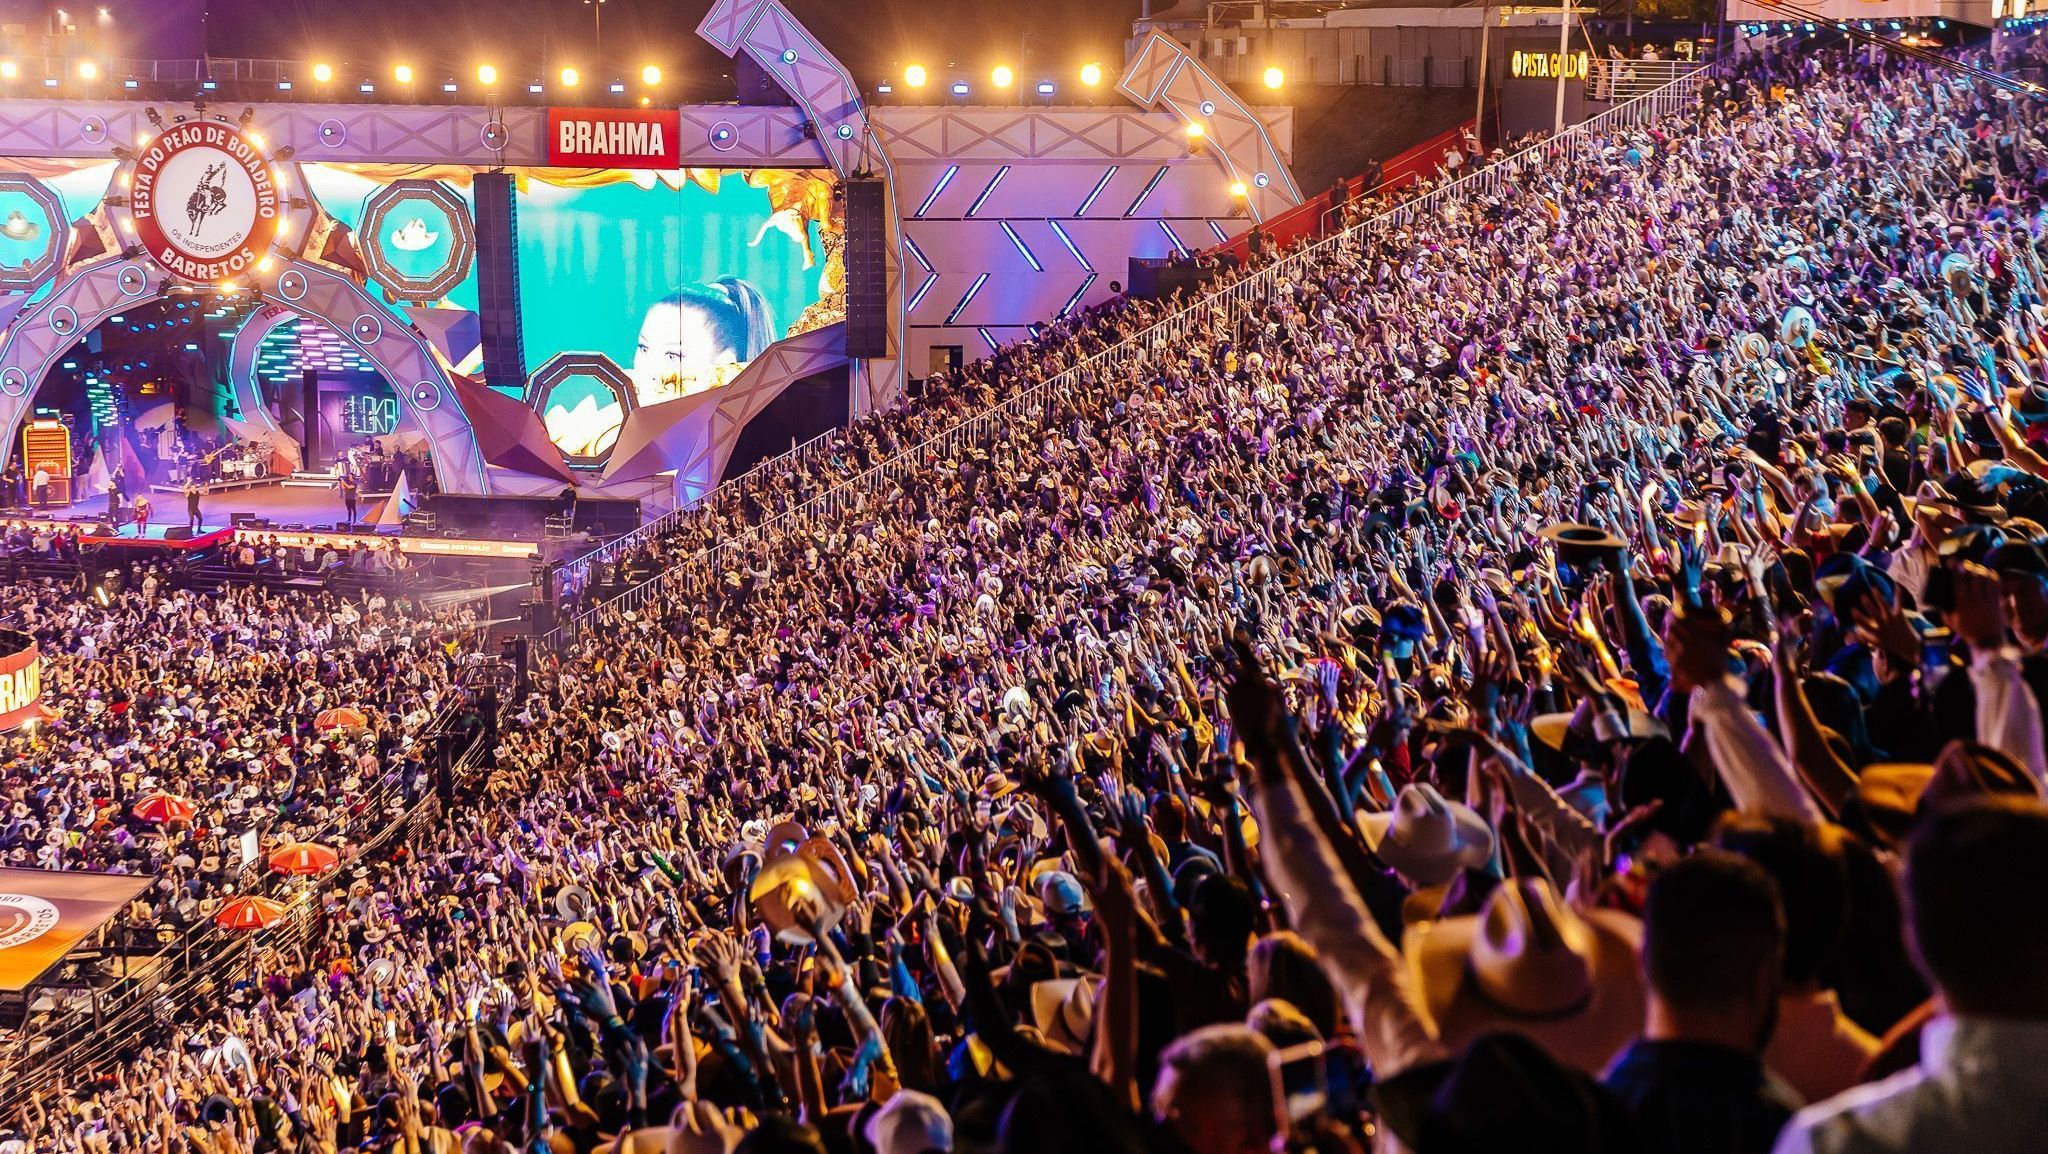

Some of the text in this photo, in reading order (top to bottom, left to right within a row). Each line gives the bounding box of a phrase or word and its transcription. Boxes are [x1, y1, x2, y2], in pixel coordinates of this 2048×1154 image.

[1522, 53, 1549, 77] PISTA
[560, 120, 665, 156] BRAHMA
[134, 124, 275, 219] FESTA DO PEÃO DE BOIADEIRO
[171, 228, 242, 253] OS INDEPENDENTES
[160, 246, 255, 280] BARRETOS
